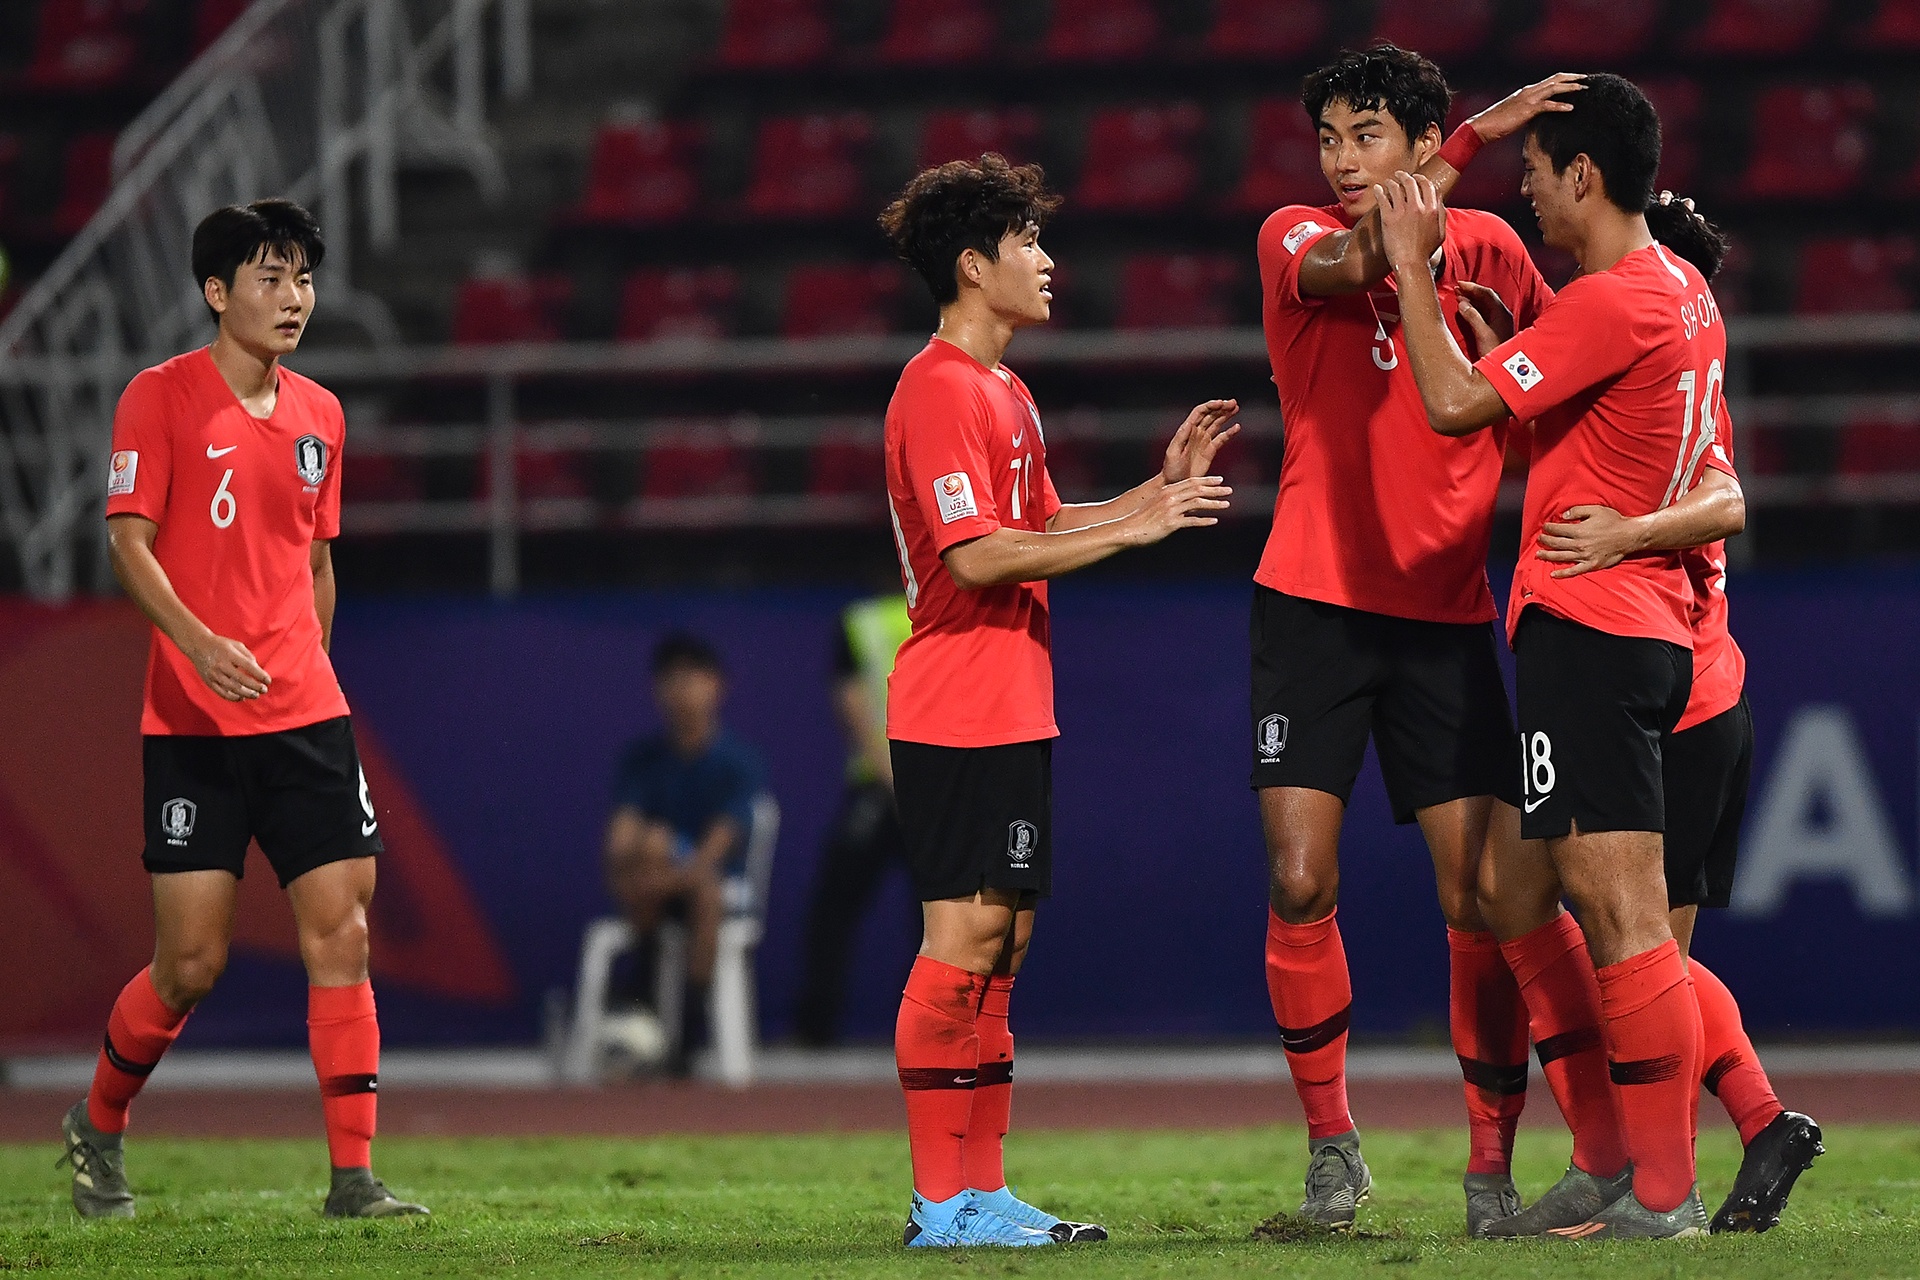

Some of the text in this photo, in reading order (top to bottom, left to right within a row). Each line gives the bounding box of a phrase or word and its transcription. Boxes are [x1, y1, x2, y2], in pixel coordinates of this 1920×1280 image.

[210, 468, 237, 529] 6
[949, 500, 967, 511] U23
[1520, 731, 1556, 795] 18
